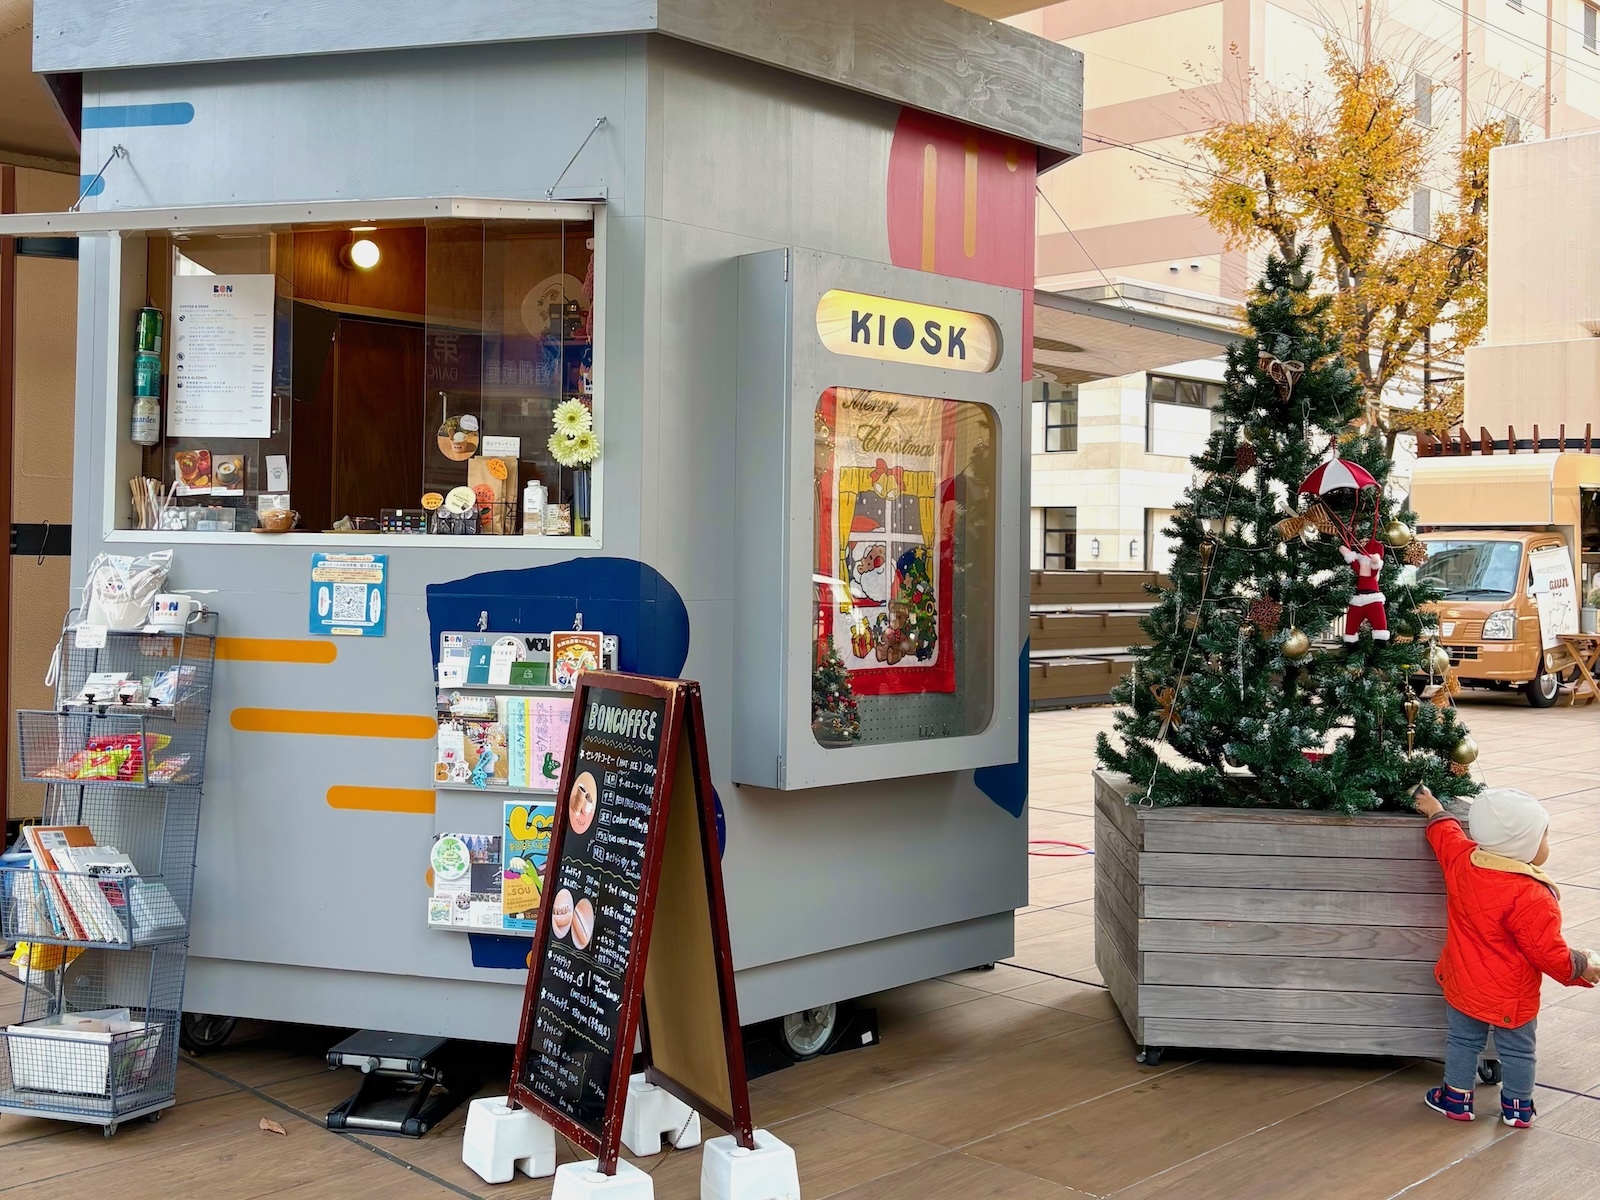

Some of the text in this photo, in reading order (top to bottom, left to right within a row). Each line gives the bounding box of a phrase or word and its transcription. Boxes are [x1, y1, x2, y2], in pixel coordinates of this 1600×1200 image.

[851, 310, 967, 360] KIOSK
[842, 389, 900, 424] Merry
[857, 424, 936, 458] Christmas
[155, 601, 179, 611] BON
[444, 635, 462, 643] BON
[588, 702, 658, 741] BONCOFFEE
[512, 886, 531, 896] SOU
